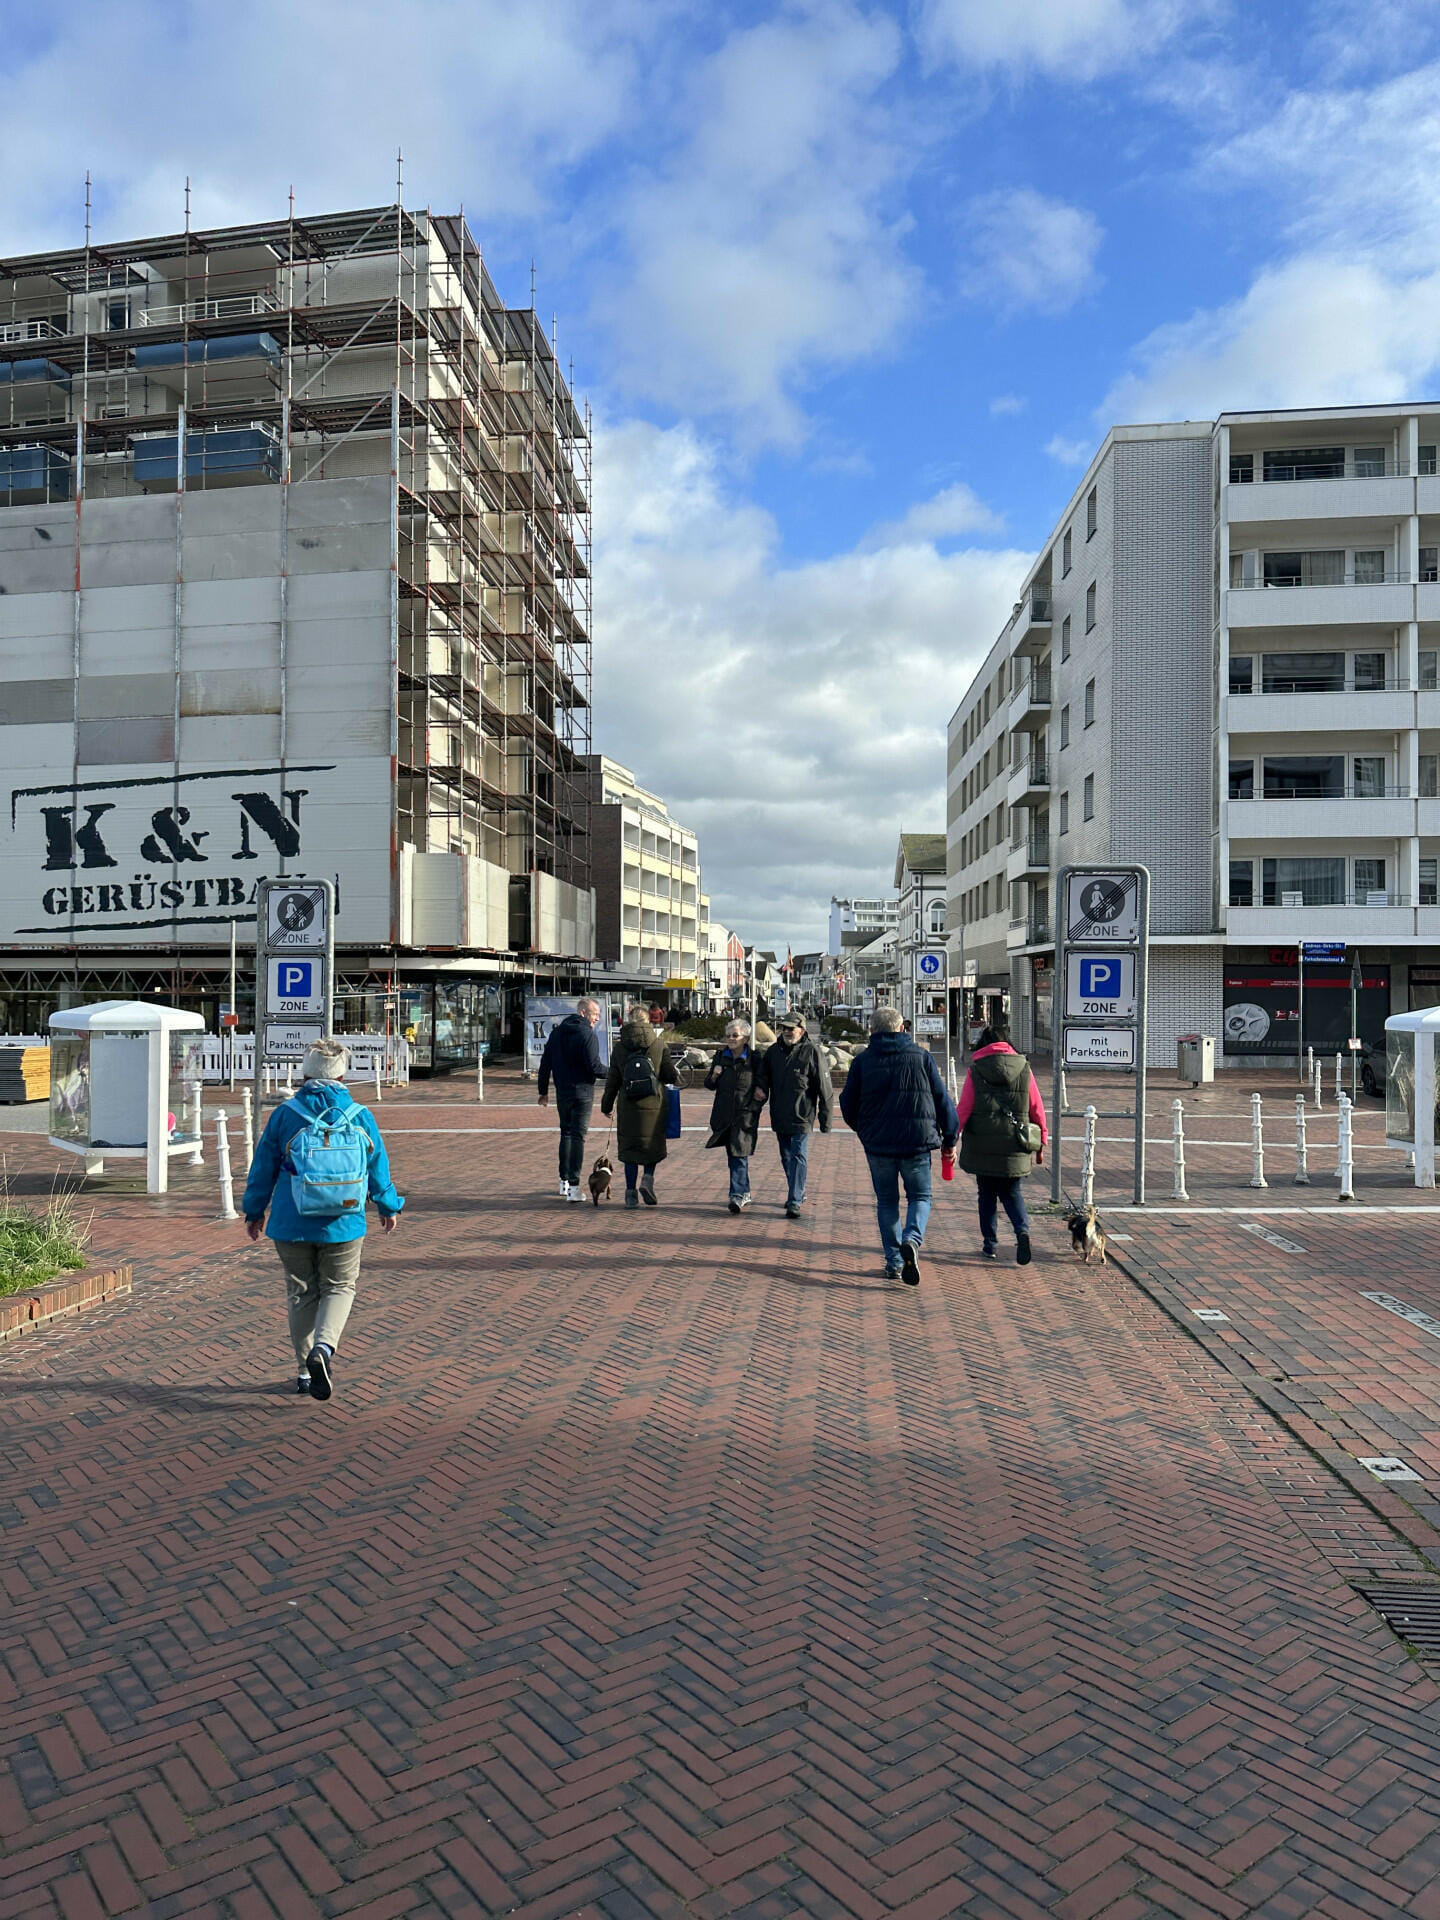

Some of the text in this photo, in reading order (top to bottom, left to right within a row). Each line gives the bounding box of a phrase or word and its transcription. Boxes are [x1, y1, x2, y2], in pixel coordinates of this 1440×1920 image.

[40, 789, 309, 870] K & N
[42, 873, 306, 915] GERÜSTB
[1085, 925, 1120, 937] ZONE
[281, 934, 310, 943] ZONE
[285, 967, 304, 993] P
[1090, 964, 1111, 993] P
[279, 1001, 309, 1011] ZONE
[1082, 1002, 1118, 1014] ZONE
[286, 1031, 301, 1039] mit
[532, 1020, 547, 1039] K
[269, 1041, 310, 1050] Parksche
[1091, 1036, 1109, 1047] mit
[1070, 1047, 1129, 1058] Parkschein
